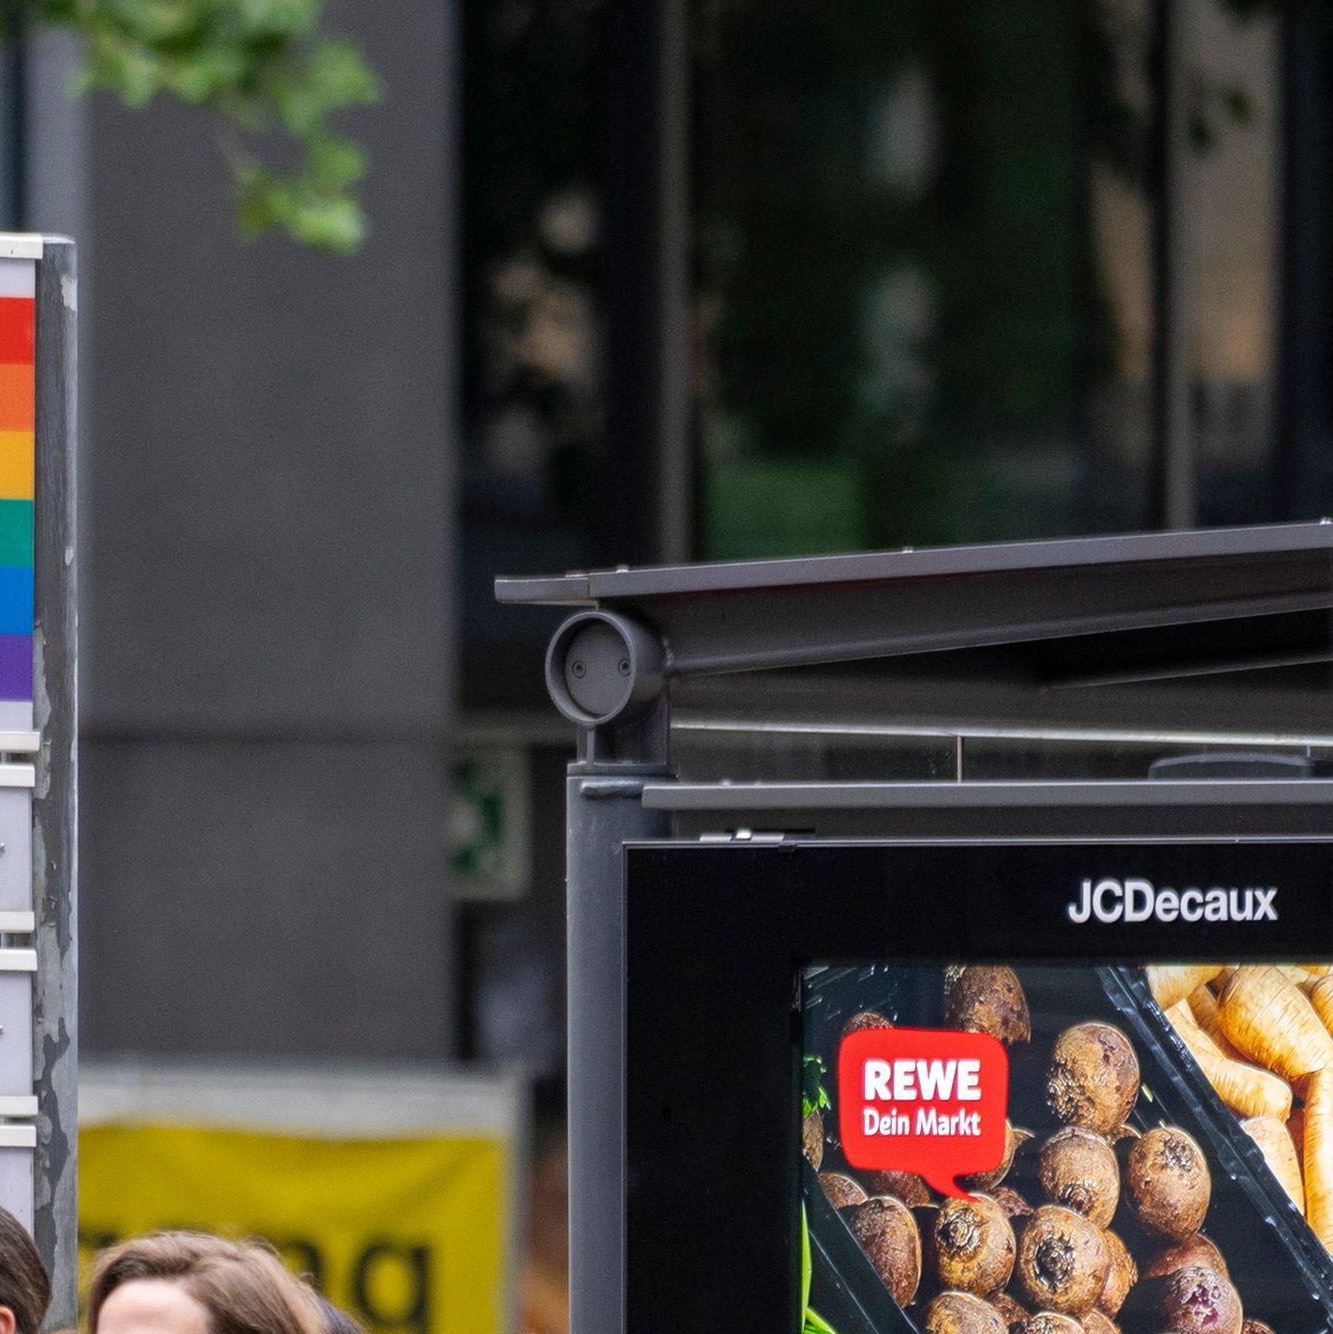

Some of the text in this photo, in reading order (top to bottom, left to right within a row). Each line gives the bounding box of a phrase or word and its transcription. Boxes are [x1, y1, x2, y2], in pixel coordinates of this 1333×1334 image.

[1068, 878, 1278, 924] JCDecaux
[863, 1058, 982, 1101] REWE
[863, 1106, 982, 1136] Dein Markt
